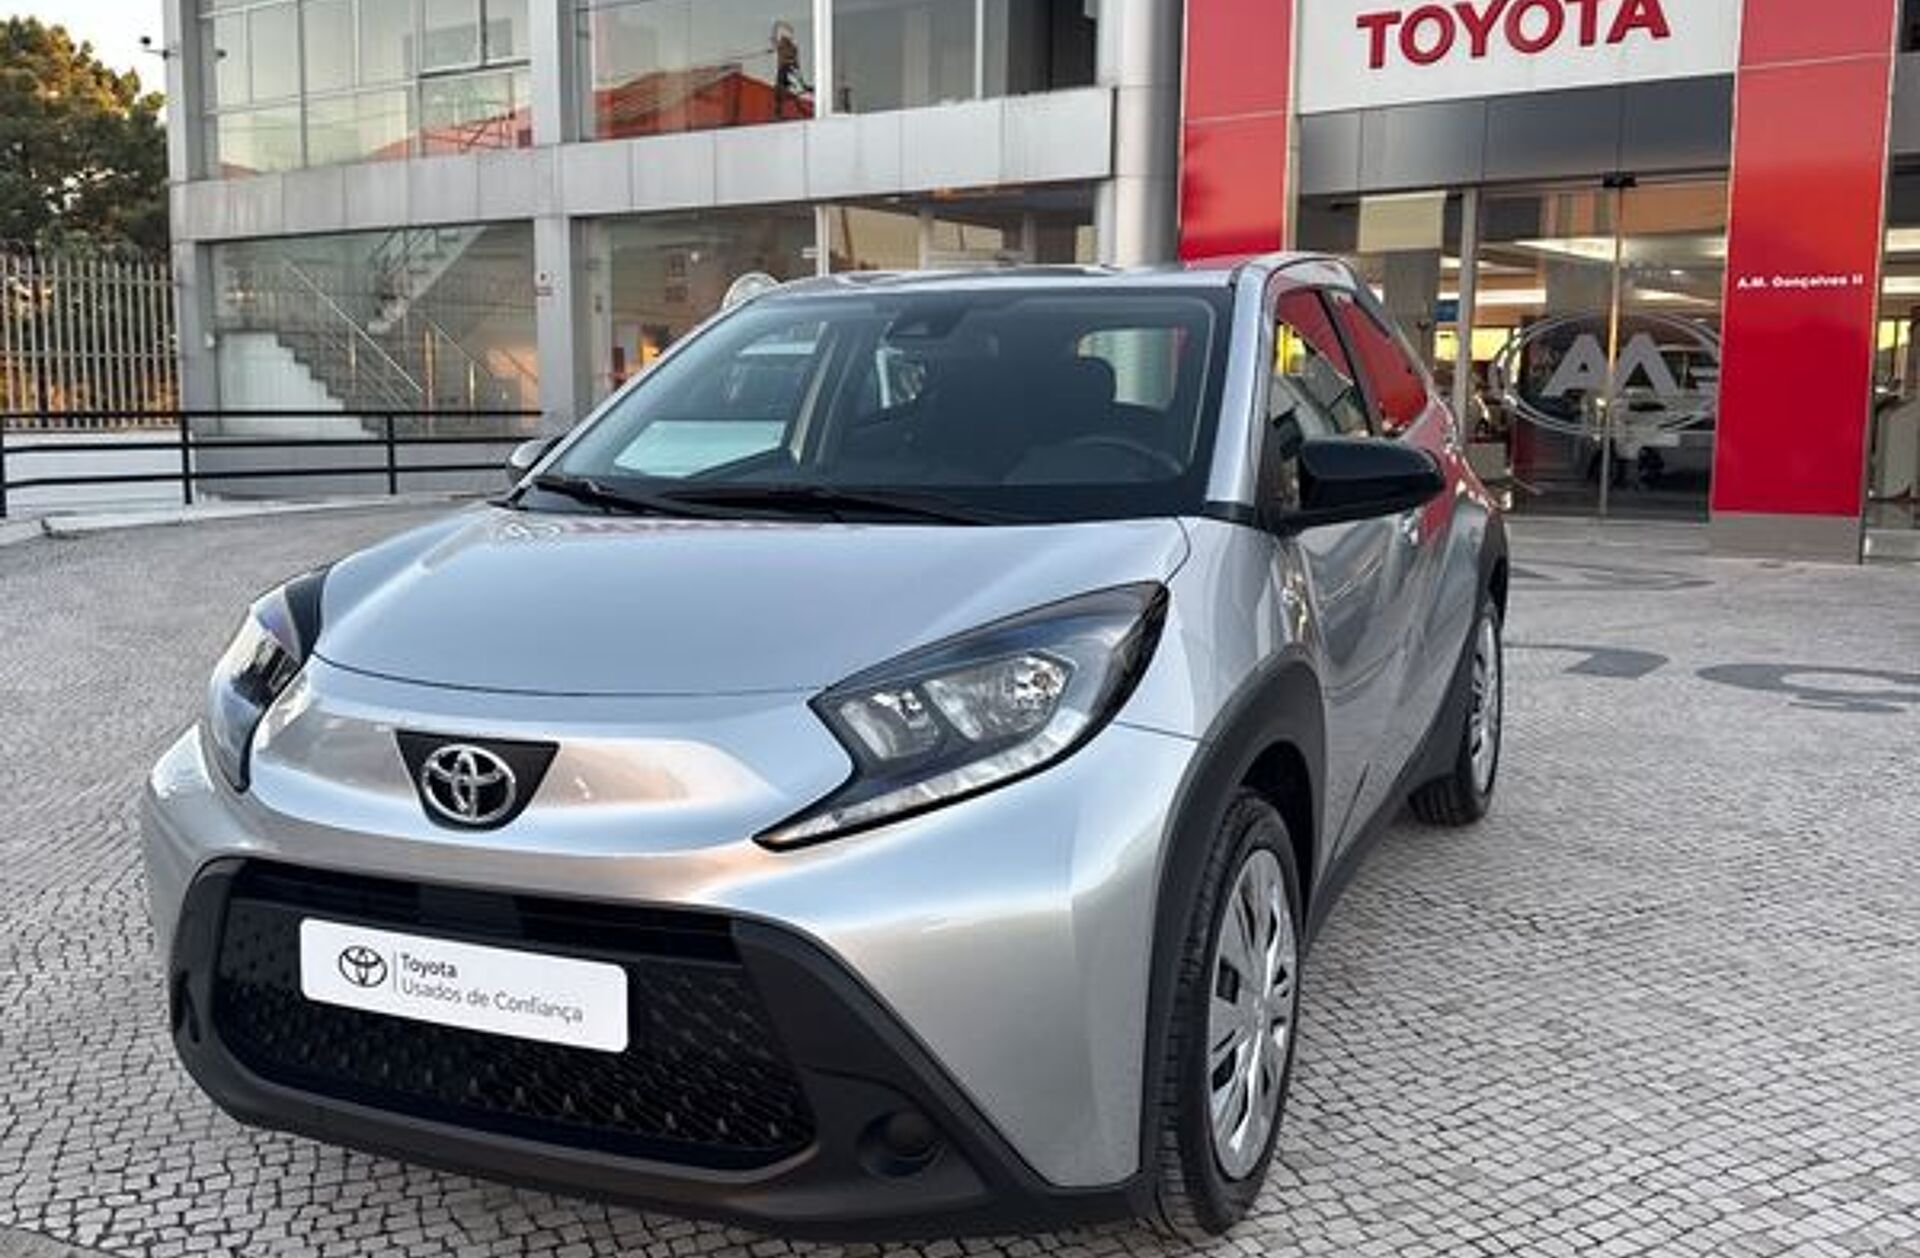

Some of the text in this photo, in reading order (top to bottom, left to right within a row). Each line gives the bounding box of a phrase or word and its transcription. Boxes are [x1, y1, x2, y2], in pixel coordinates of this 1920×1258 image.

[1357, 0, 1670, 69] TOYOTA
[402, 953, 458, 978] Toyota
[402, 979, 584, 1025] Usados de Confiança
